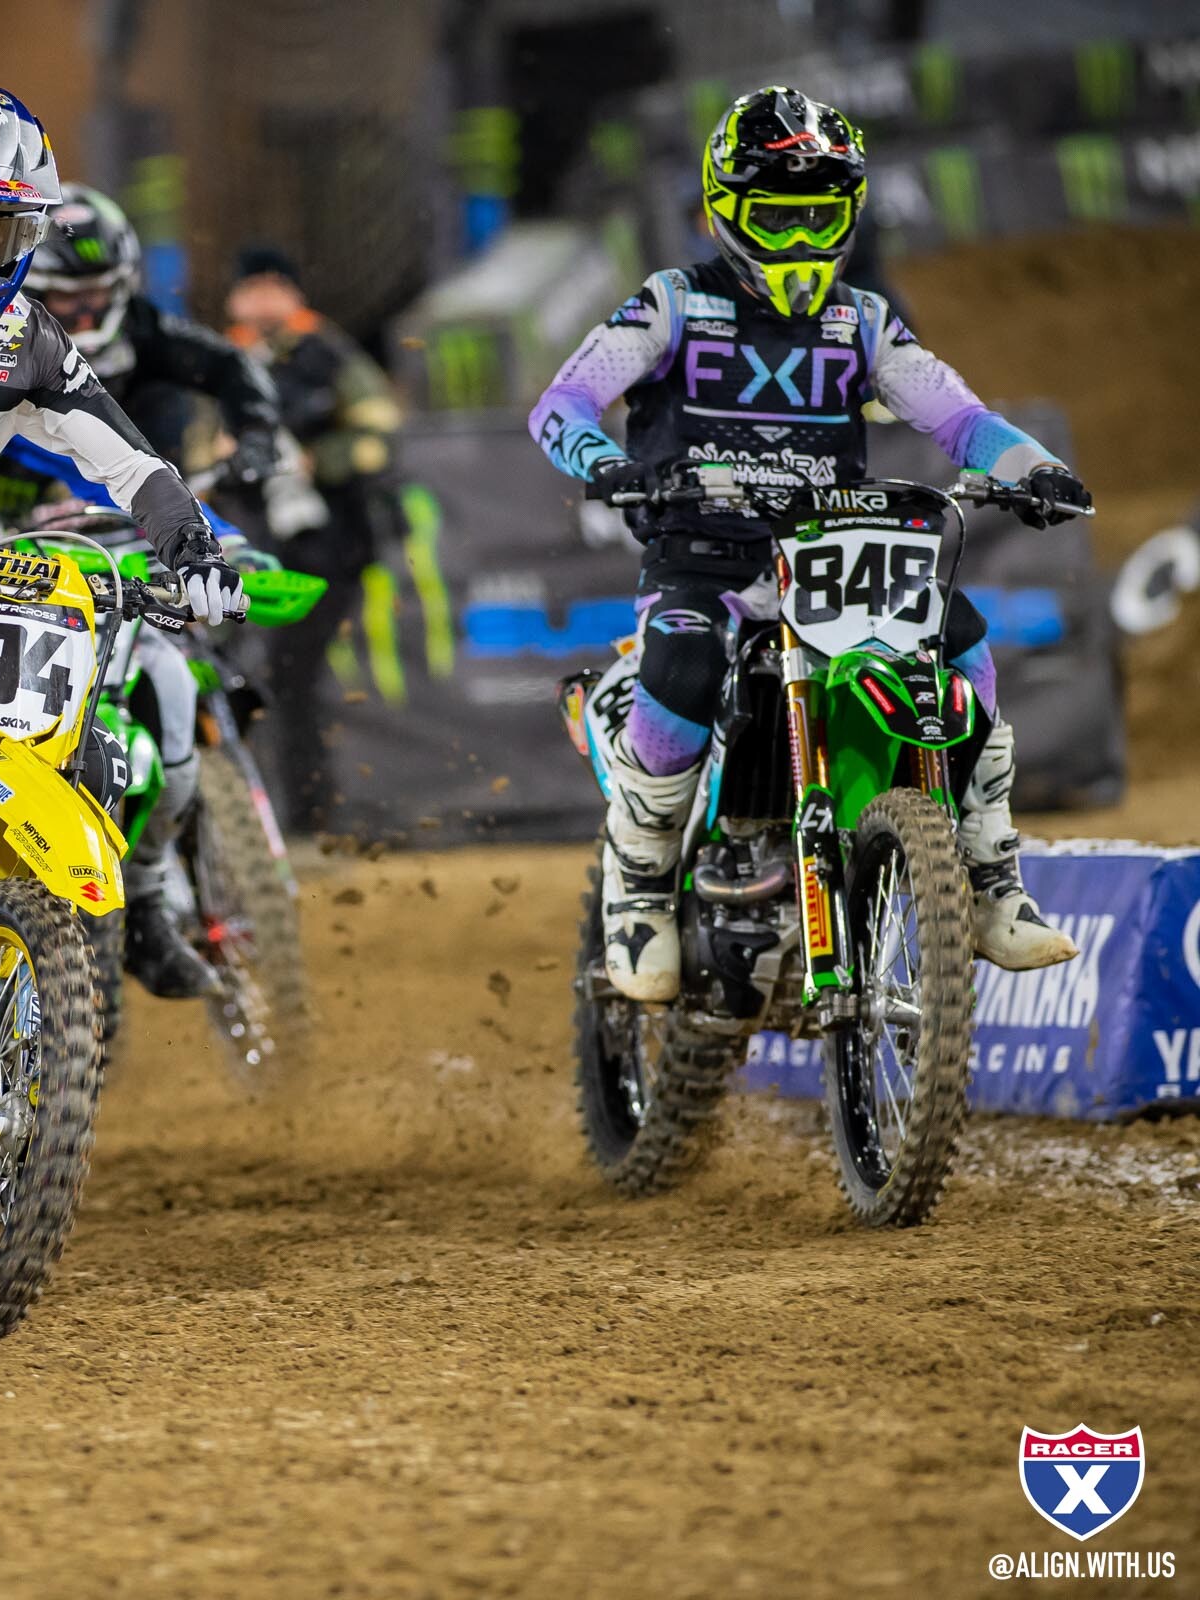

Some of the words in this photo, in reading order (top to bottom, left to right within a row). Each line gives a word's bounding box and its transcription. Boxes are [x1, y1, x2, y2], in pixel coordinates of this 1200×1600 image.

[685, 340, 858, 408] FXR
[823, 516, 901, 528] SUPERCROSS
[794, 541, 936, 626] 848
[144, 613, 185, 630] ARC
[20, 820, 52, 854] MAYHEM
